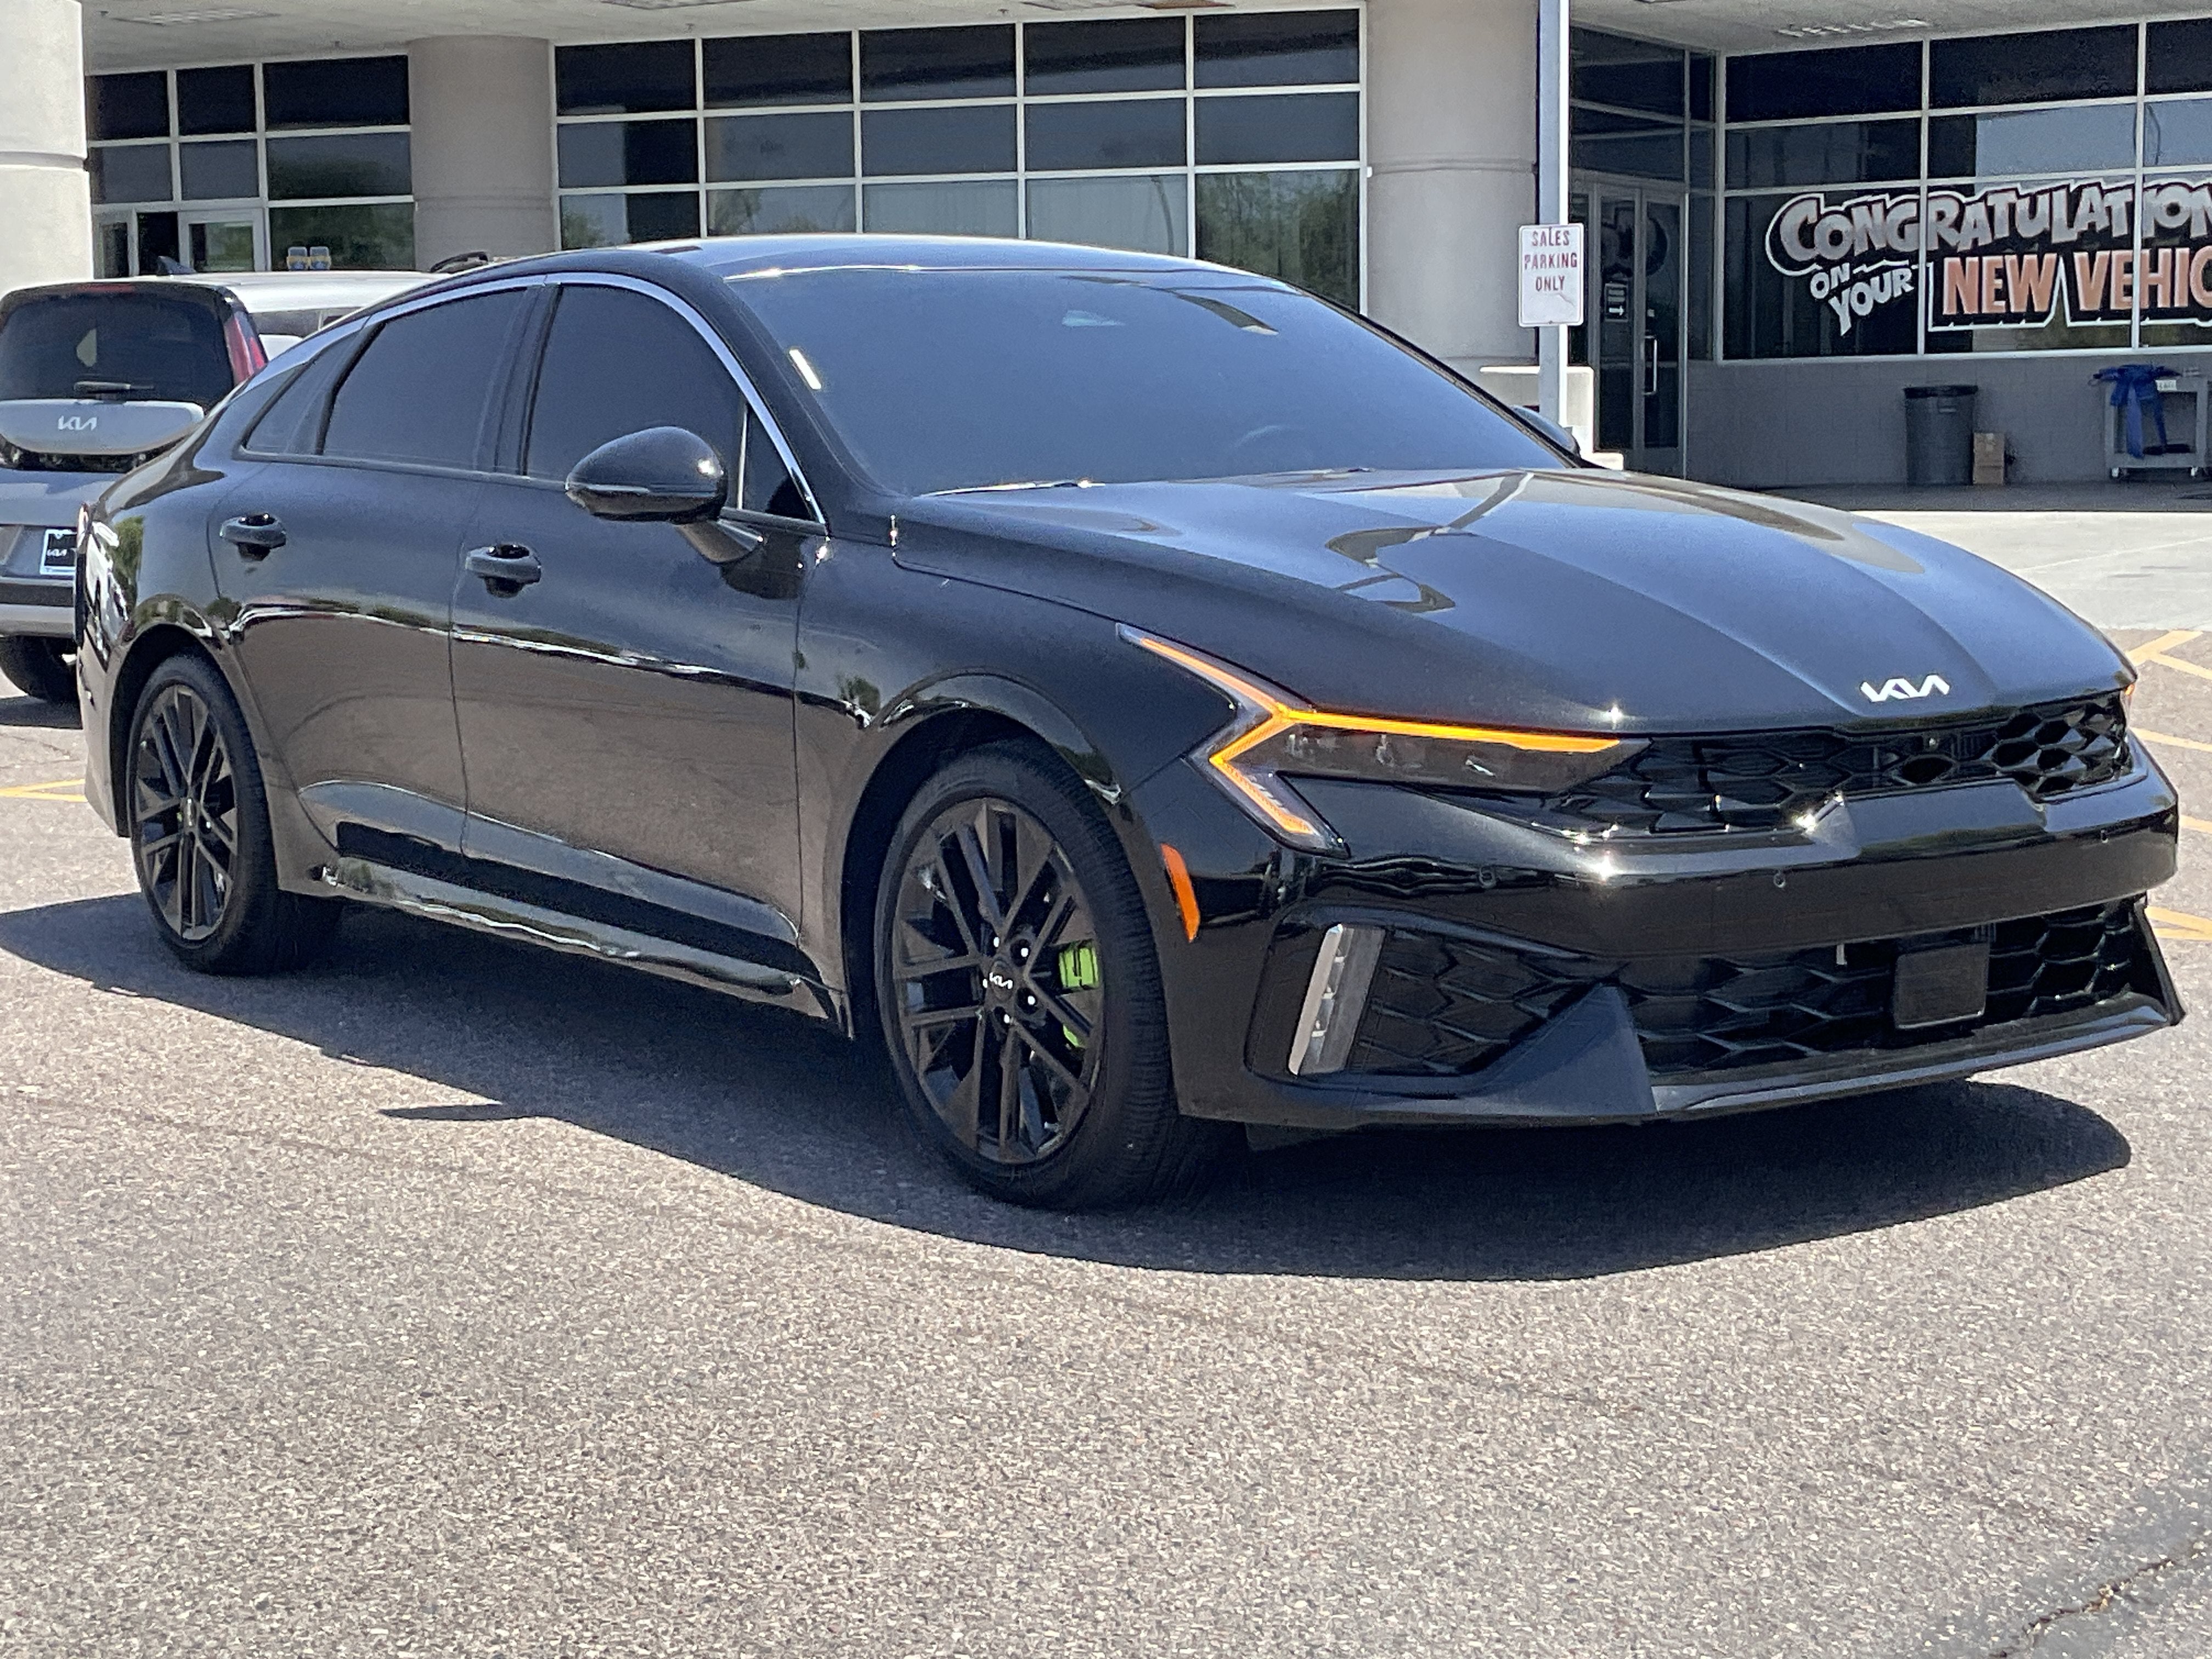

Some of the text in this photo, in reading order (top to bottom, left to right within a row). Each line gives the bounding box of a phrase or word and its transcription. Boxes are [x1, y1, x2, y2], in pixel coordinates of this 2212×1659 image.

[1531, 228, 1570, 246] SALES
[1525, 252, 1577, 270] PARKING
[1536, 275, 1565, 292] ONLY
[1810, 263, 1850, 300] ON
[1943, 253, 2057, 315] NEW
[1828, 268, 1915, 337] YOUR
[58, 415, 97, 431] KIA
[1860, 675, 1950, 703] KIA
